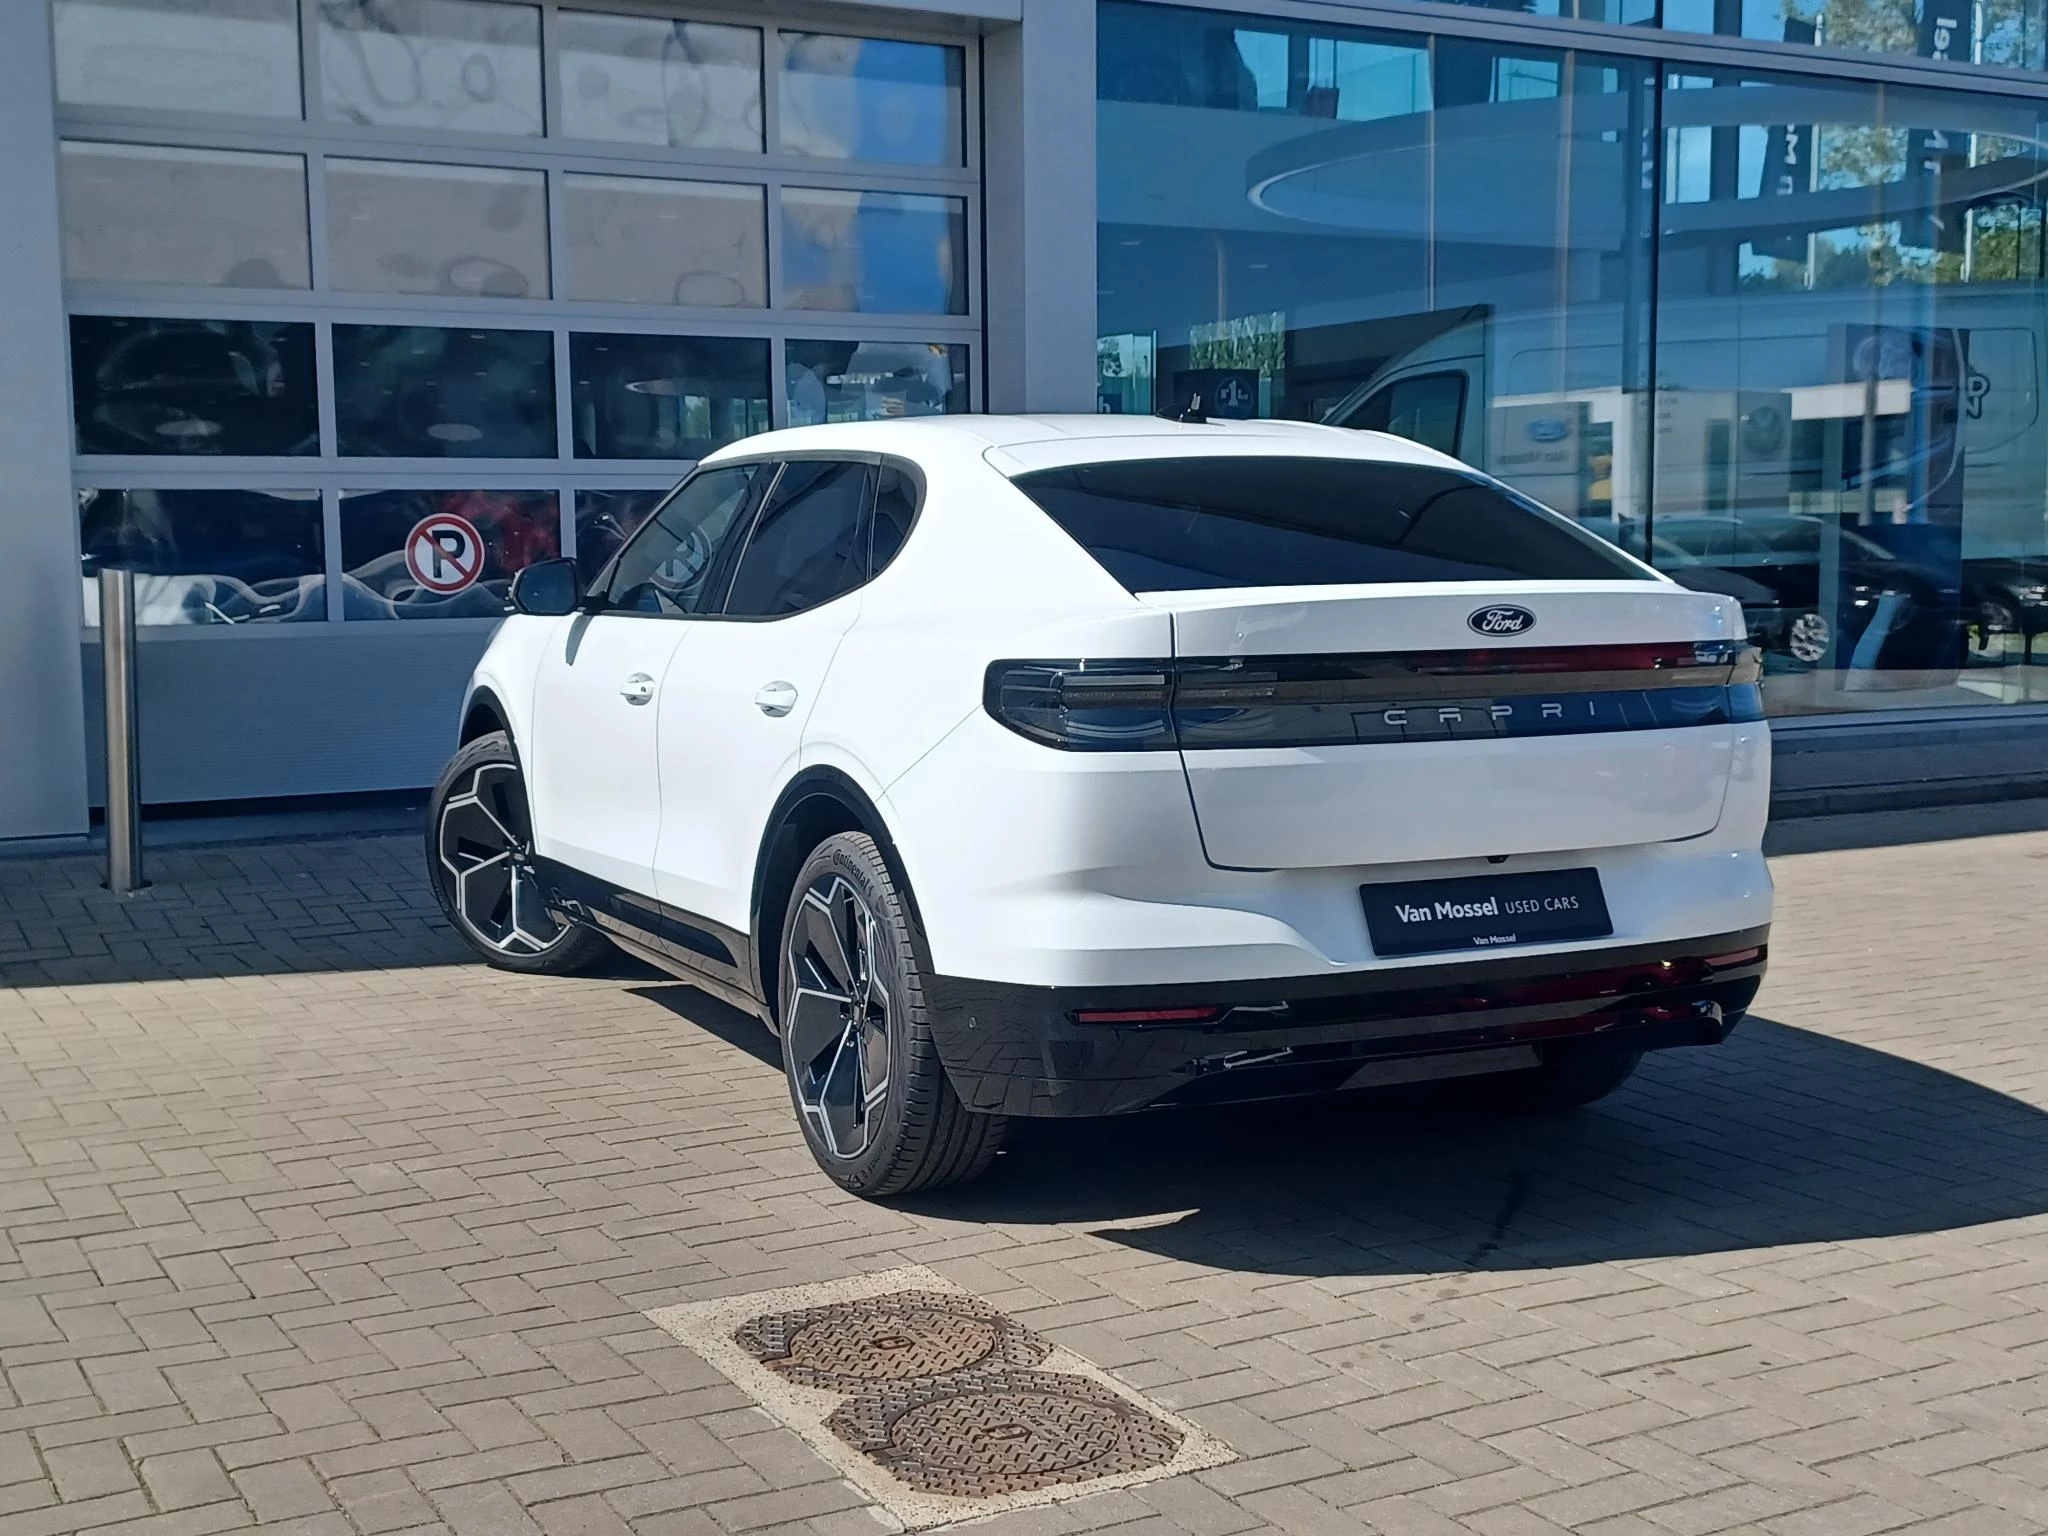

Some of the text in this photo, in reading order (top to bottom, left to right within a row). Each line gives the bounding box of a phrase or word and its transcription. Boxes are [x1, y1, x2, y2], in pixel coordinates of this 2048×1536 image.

[431, 529, 466, 579] P
[1481, 608, 1524, 632] Ford
[1383, 701, 1596, 726] CAPRI
[832, 848, 871, 891] Continental
[1395, 896, 1580, 923] Van Mossel USED CARS
[1472, 933, 1517, 946] Van Mossel
